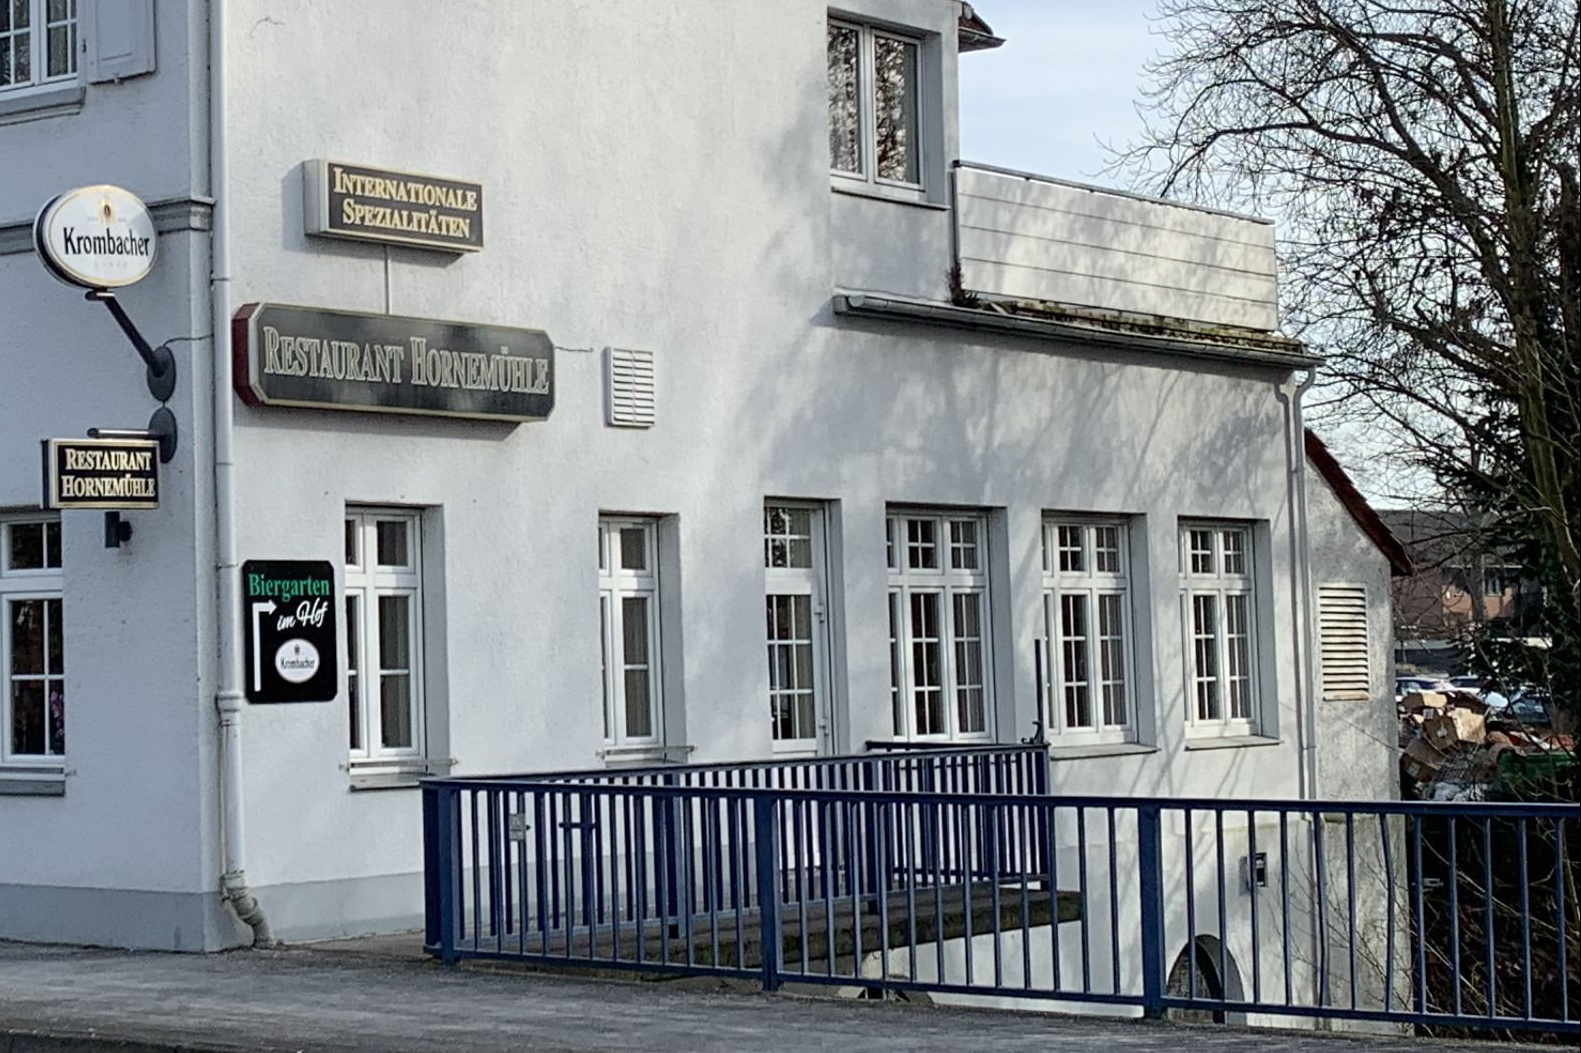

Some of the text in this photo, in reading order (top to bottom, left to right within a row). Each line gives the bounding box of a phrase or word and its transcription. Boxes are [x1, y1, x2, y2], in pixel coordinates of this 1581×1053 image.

[333, 167, 478, 212] INTERNATIONALE
[342, 198, 471, 239] SPEZIALITÄTEN
[63, 226, 150, 256] Krombacher
[263, 326, 549, 395] RESTAURANT HORNEMÜHLE
[64, 448, 152, 471] RESTAURANT
[248, 573, 331, 603] Biergarten
[276, 597, 328, 631] im Hof
[280, 657, 316, 670] Krombacher
